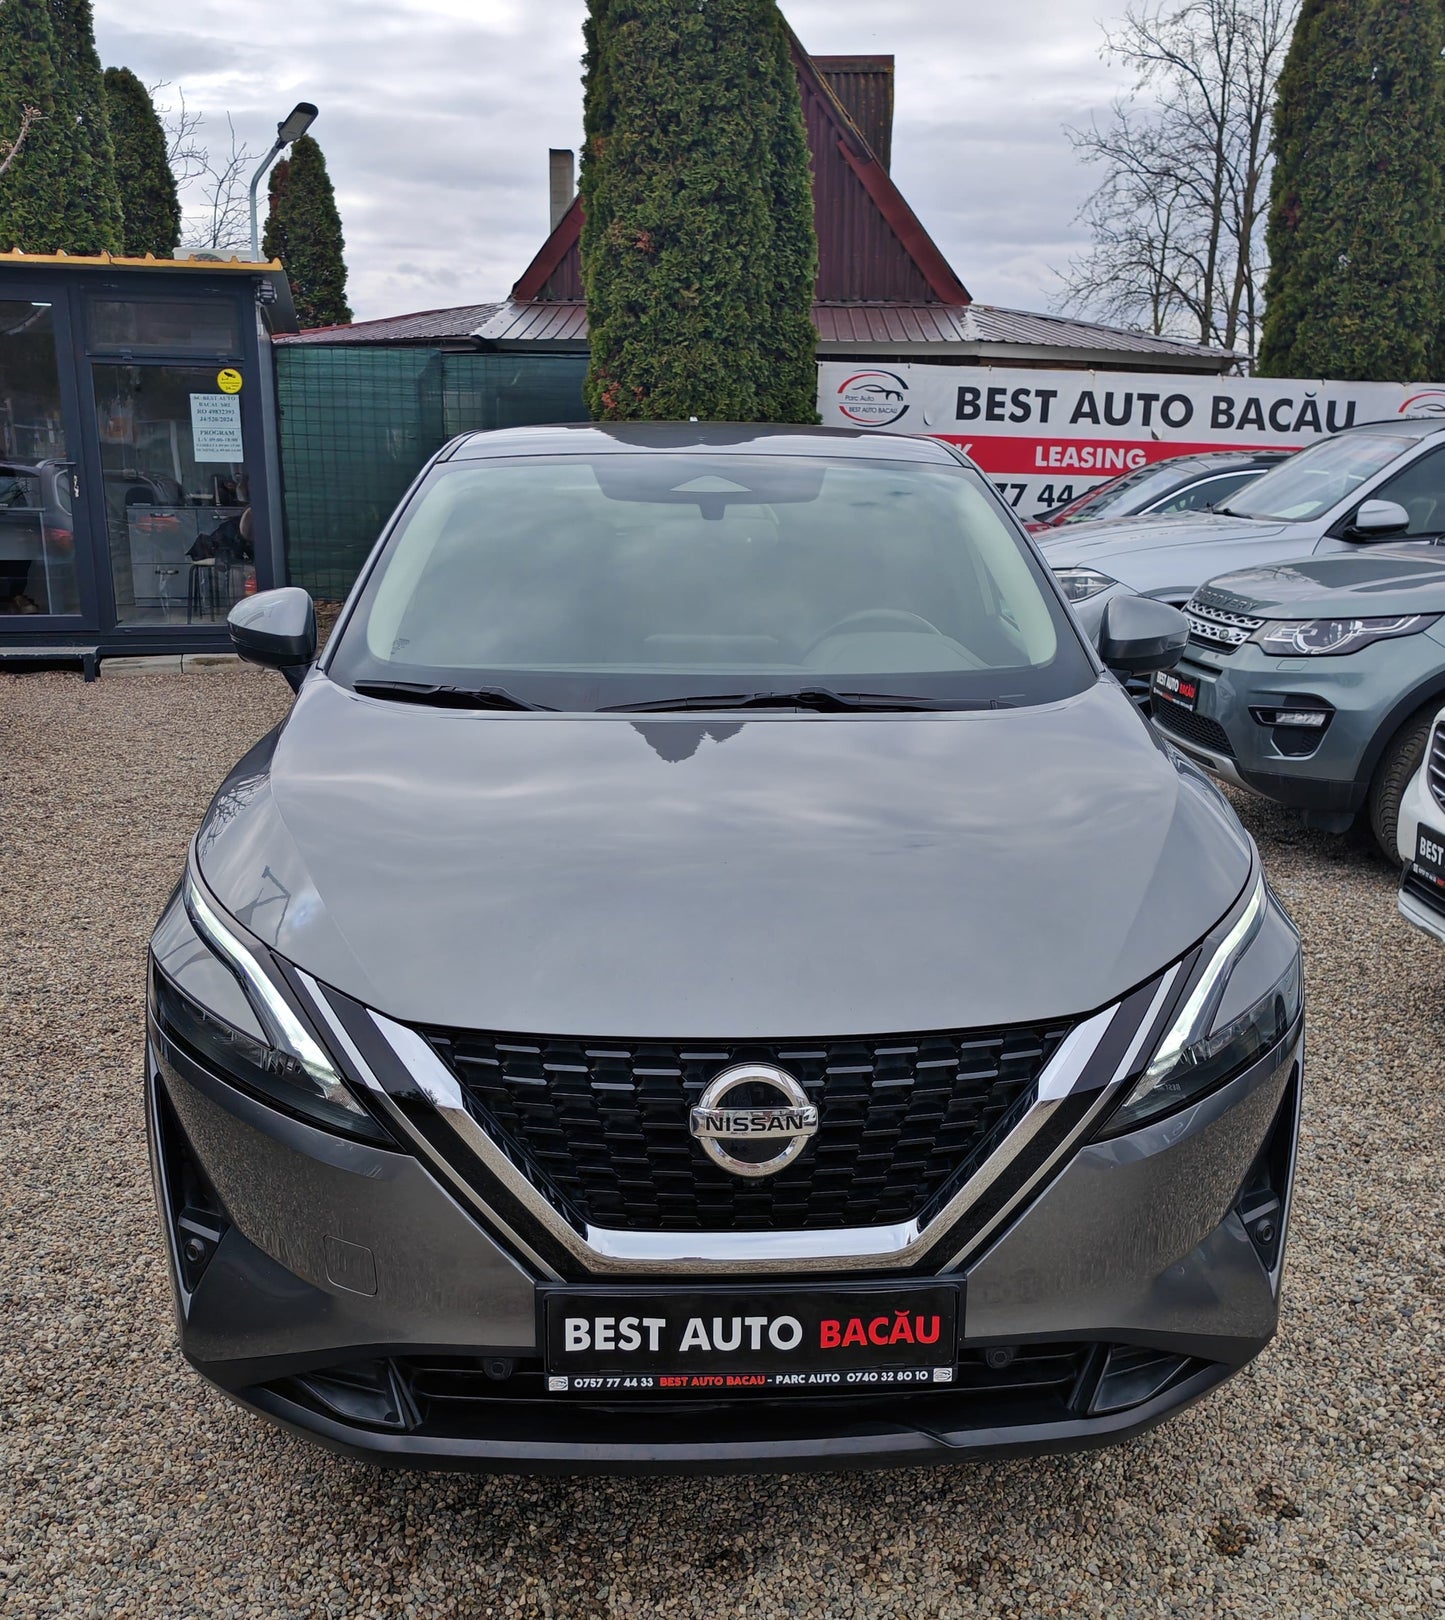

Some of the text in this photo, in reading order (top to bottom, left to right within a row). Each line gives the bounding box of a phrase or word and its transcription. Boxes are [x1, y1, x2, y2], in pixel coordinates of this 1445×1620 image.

[955, 386, 1356, 433] BEST AUTO BACĂU
[1035, 446, 1146, 470] LEASING
[1037, 484, 1073, 508] 44
[1419, 836, 1444, 866] BEST
[705, 1114, 803, 1132] NISSAN
[564, 1310, 941, 1352] BEST AUTO BACĂU
[574, 1377, 603, 1388] 0757
[606, 1377, 621, 1388] 77
[623, 1377, 638, 1387] 44
[640, 1376, 654, 1387] 33
[659, 1376, 689, 1387] BEST
[691, 1376, 724, 1386] AUTO
[726, 1375, 766, 1386] BACAU
[775, 1374, 806, 1384] PARC
[808, 1373, 841, 1384] AUTO
[846, 1372, 878, 1382] 0740
[881, 1371, 894, 1382] 32
[897, 1371, 912, 1381] 80
[915, 1370, 929, 1381] 10
